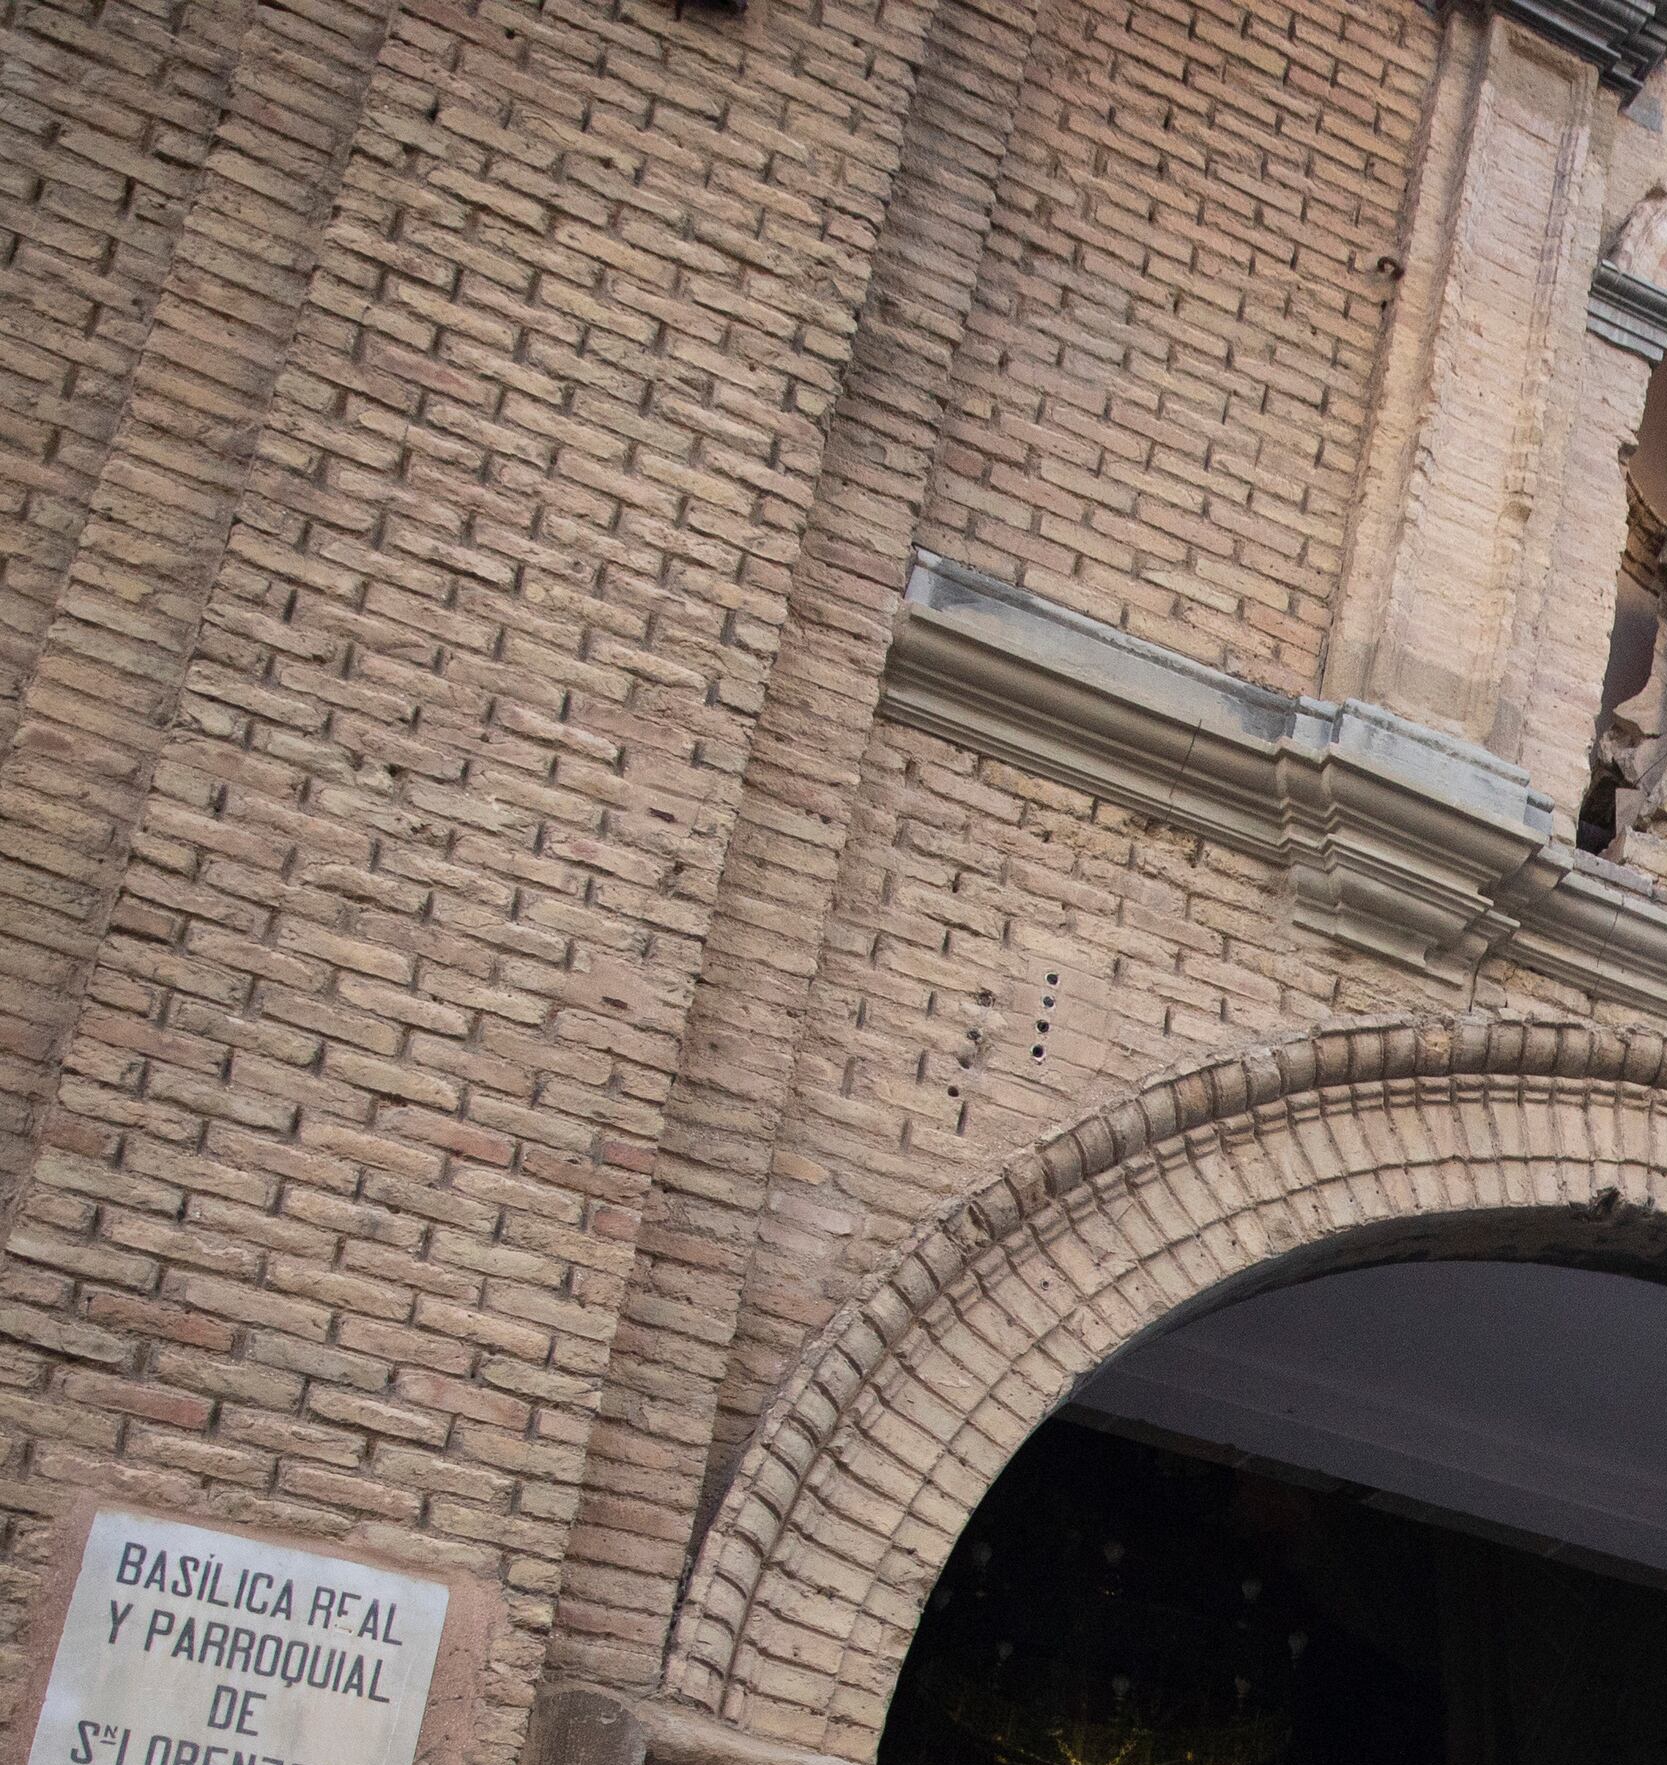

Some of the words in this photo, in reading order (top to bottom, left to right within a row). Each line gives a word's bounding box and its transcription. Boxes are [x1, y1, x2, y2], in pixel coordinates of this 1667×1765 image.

[115, 1541, 294, 1621] BASÍLICA
[107, 1599, 135, 1645] Y
[143, 1608, 391, 1704] PARROQUIAL
[206, 1683, 268, 1737] DE
